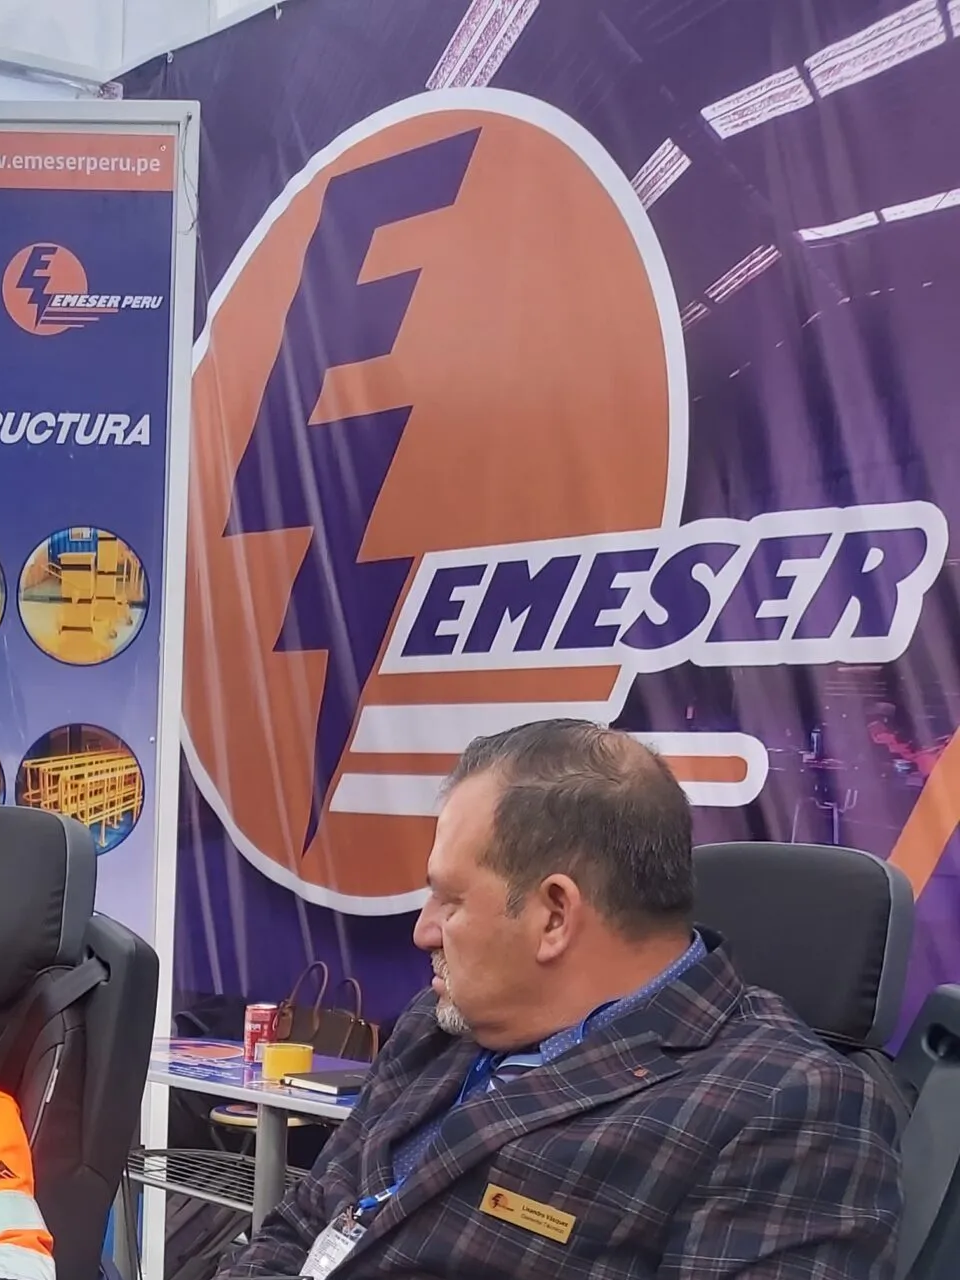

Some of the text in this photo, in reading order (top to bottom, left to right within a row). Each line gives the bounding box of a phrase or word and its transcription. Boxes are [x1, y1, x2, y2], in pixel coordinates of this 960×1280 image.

[51, 294, 164, 309] EMESER PERU
[401, 525, 929, 658] EMESER
